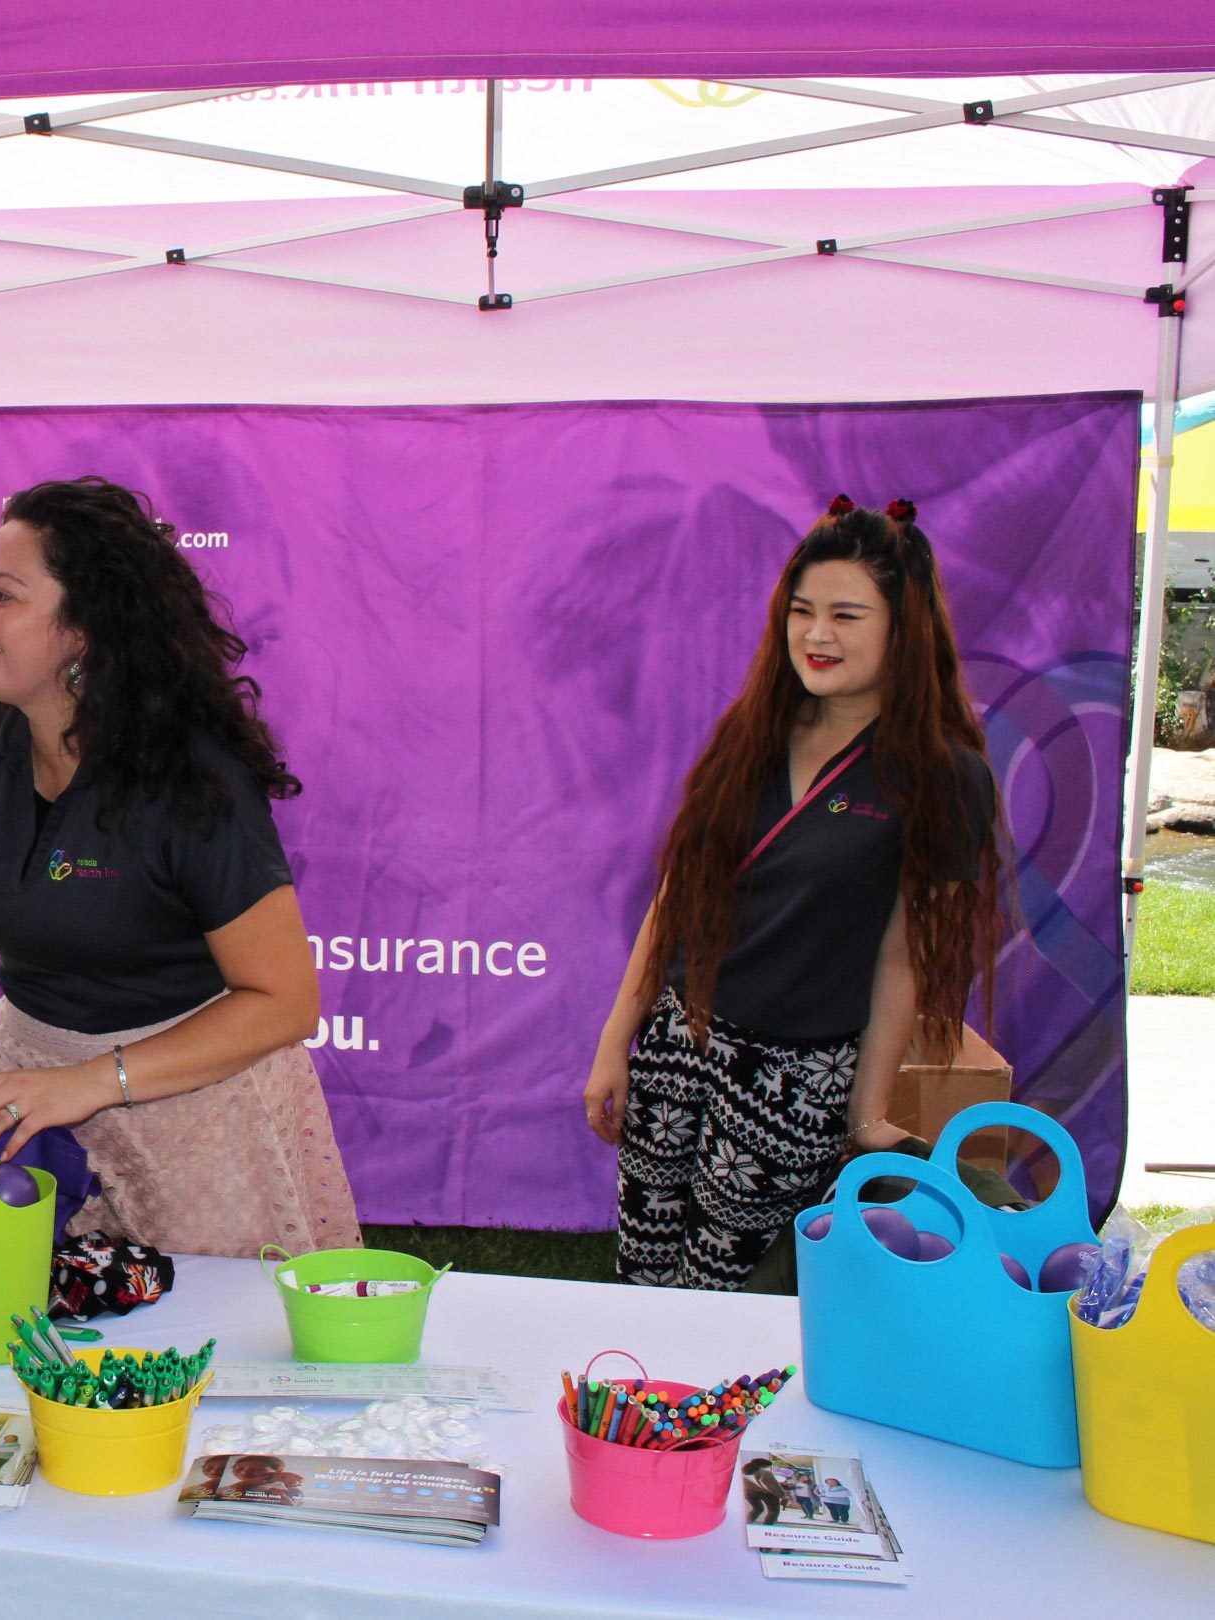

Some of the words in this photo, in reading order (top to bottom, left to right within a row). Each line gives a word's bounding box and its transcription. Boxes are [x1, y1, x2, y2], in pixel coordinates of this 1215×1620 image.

[306, 934, 547, 978] nsurance
[302, 1014, 380, 1052] ou.
[369, 1470, 393, 1478] full
[349, 1475, 384, 1485] keep
[384, 1478, 410, 1486] you
[764, 1531, 820, 1540] Resource
[824, 1535, 861, 1544] Guide
[782, 1560, 841, 1569] Resource
[844, 1563, 882, 1572] Guide
